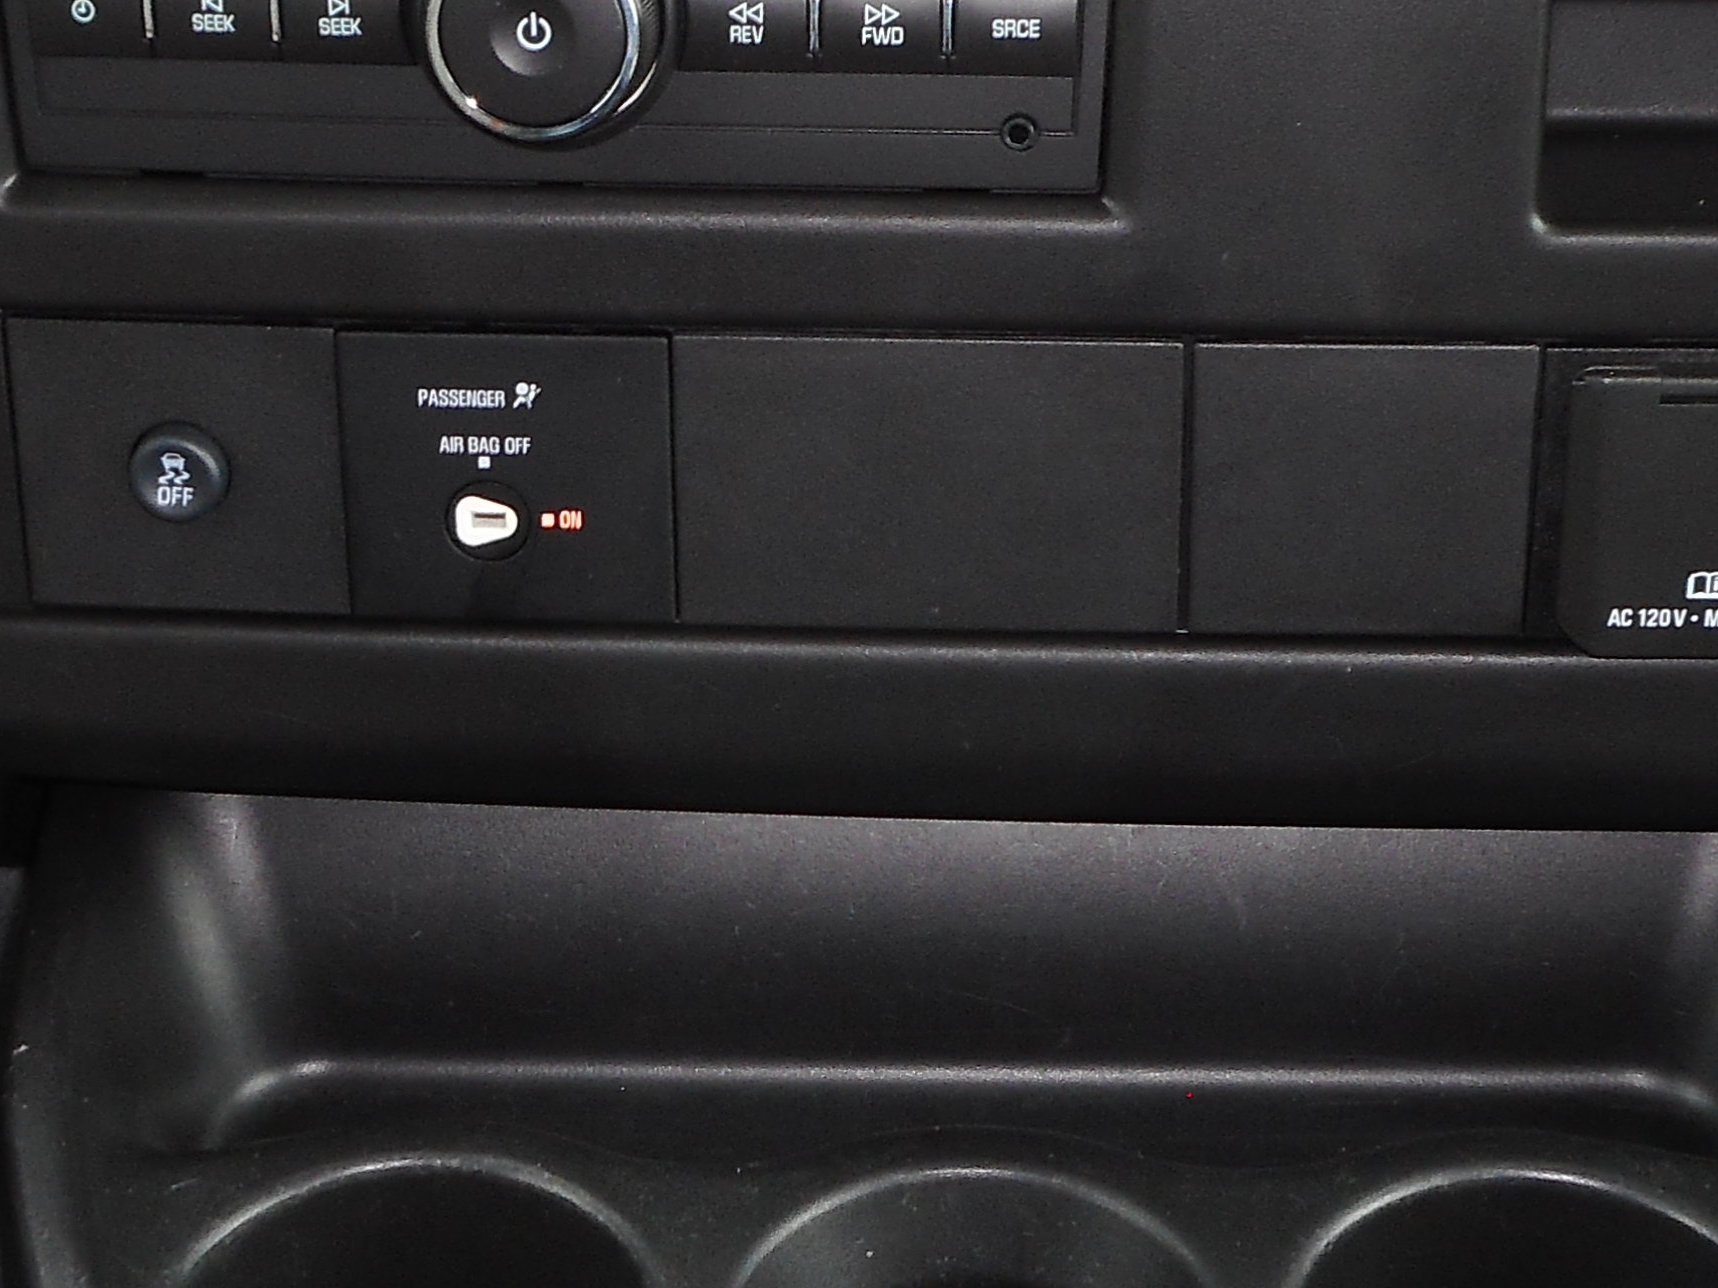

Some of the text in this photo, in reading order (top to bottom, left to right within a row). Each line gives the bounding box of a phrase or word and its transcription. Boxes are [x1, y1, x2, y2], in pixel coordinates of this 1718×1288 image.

[191, 13, 236, 34] SEEK
[317, 16, 362, 38] SEEK
[991, 18, 1041, 40] SRCE
[729, 24, 764, 45] REV
[861, 26, 904, 47] FWD
[417, 387, 506, 409] PASSENGER
[438, 435, 532, 456] AIR BAG OFF
[156, 485, 195, 508] OFF
[558, 510, 583, 531] ON
[1606, 608, 1633, 628] AC
